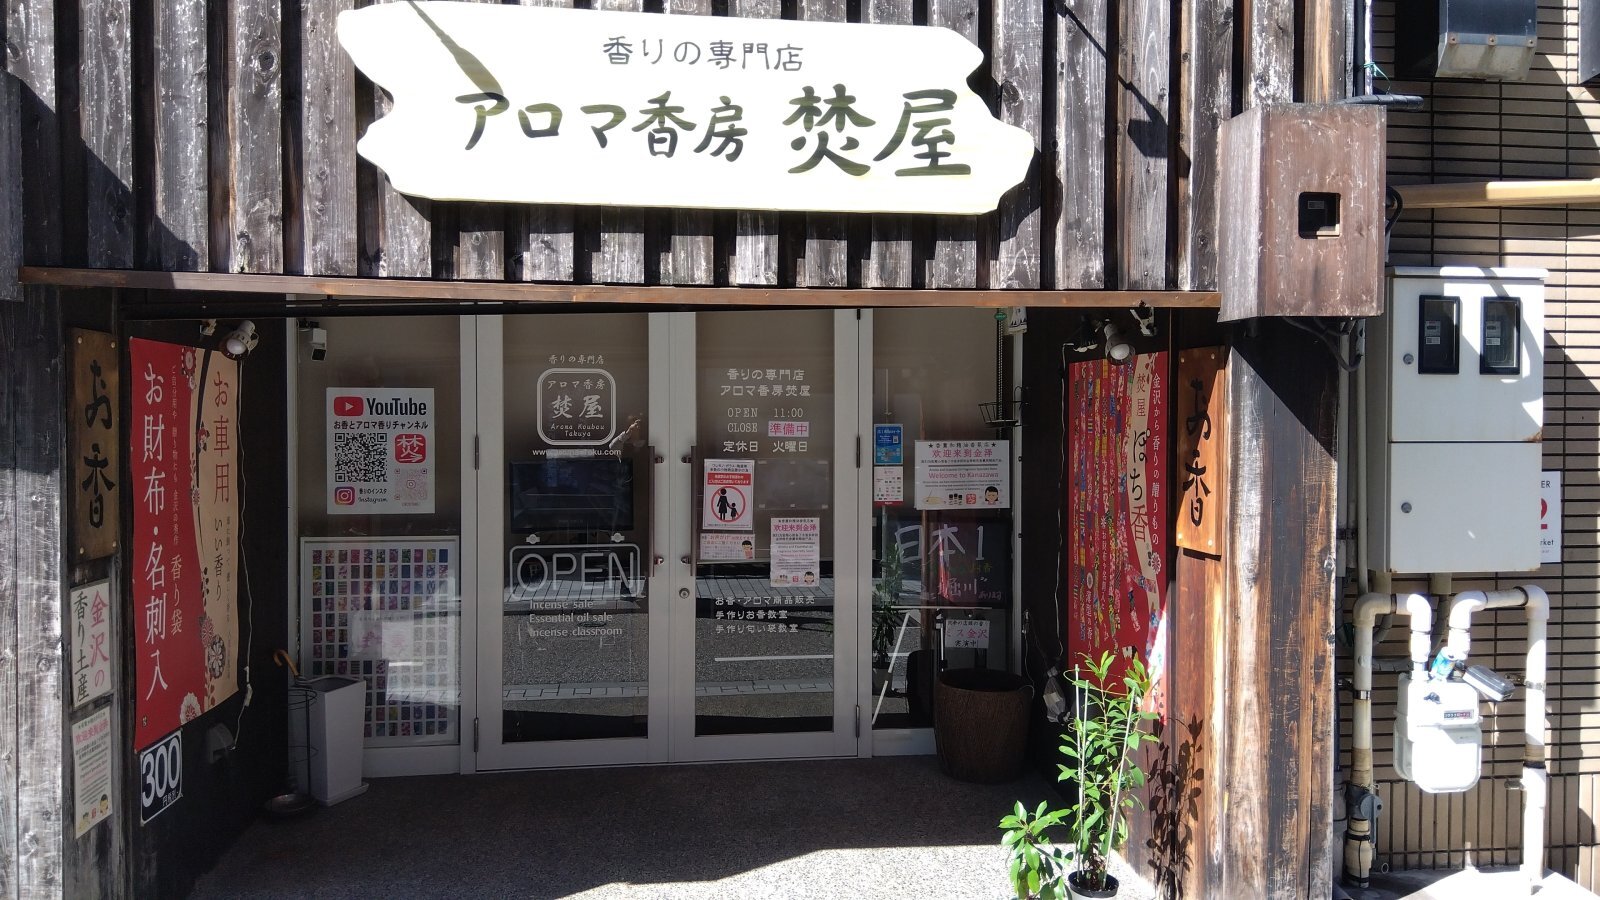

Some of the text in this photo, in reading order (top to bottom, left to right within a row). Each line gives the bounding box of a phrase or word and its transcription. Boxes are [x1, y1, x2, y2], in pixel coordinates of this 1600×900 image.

[602, 36, 804, 72] 香りの専門店
[455, 84, 971, 177] アロマ香房 焚屋
[549, 354, 604, 364] 香りの専門店
[547, 379, 605, 390] アロマ香房
[727, 368, 805, 381] 香りの専門店
[1136, 373, 1146, 417] 焚屋
[366, 398, 427, 416] YouTube
[552, 394, 604, 419] 焚屋
[727, 407, 803, 418] OPEN 11:00
[333, 420, 428, 430] お香とアロマ香りチャンネル
[564, 430, 591, 438] Takuya
[727, 422, 808, 436] CLOSE 準備中
[82, 359, 116, 529] お香
[213, 371, 230, 504] お車用
[723, 441, 808, 452] 定休日 火曜日
[932, 448, 993, 458] 欢迎来到金泽
[1151, 373, 1161, 545] 金沢から香りの贈りもの
[1182, 377, 1212, 527] お香
[1130, 430, 1151, 543] ぽち香
[143, 362, 169, 701] お財布・名刺入
[517, 552, 634, 592] OPEN
[170, 554, 183, 636] 香り袋
[530, 600, 594, 609] Incense sale
[715, 596, 815, 606] お香・アロマ商品販売
[529, 612, 613, 623] Essential oil sale
[715, 610, 788, 620] 手作りお香教室
[91, 590, 109, 688] 金沢の
[572, 627, 623, 636] classroom
[74, 591, 90, 703] 香り土産
[142, 737, 180, 808] 300
